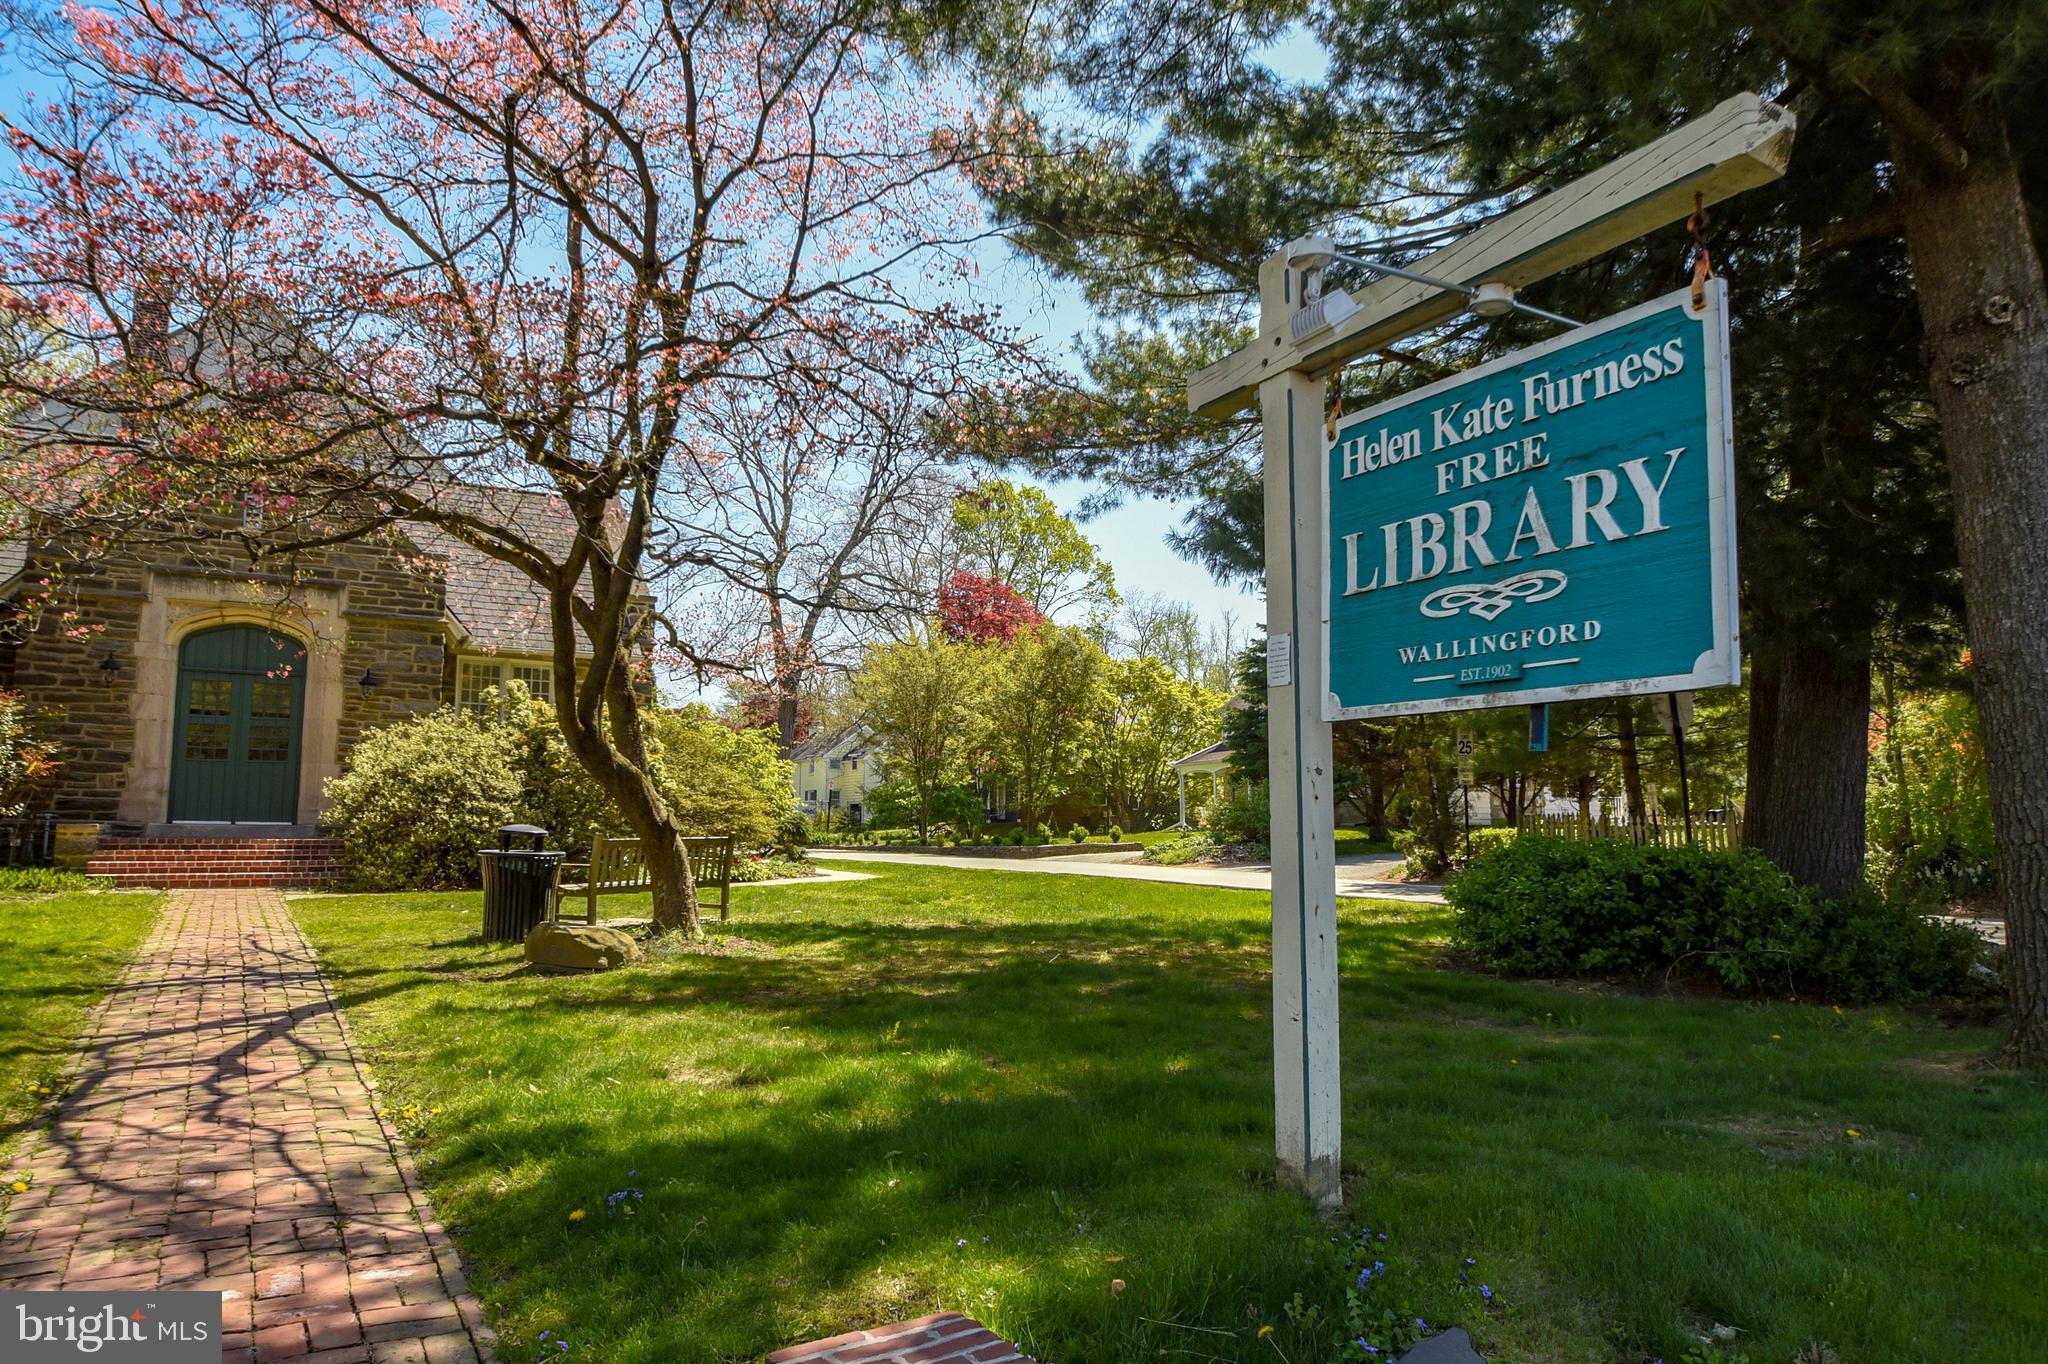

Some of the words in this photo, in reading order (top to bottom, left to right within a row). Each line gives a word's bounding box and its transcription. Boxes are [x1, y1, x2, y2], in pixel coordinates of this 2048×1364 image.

[1340, 425, 1421, 480] Helen
[1432, 394, 1514, 451] Kate
[1521, 337, 1685, 423] Furness
[1435, 432, 1550, 495] FREE
[1341, 447, 1686, 597] LIBRARY
[1398, 620, 1602, 665] WALLINGFORD
[1458, 740, 1472, 754] 25
